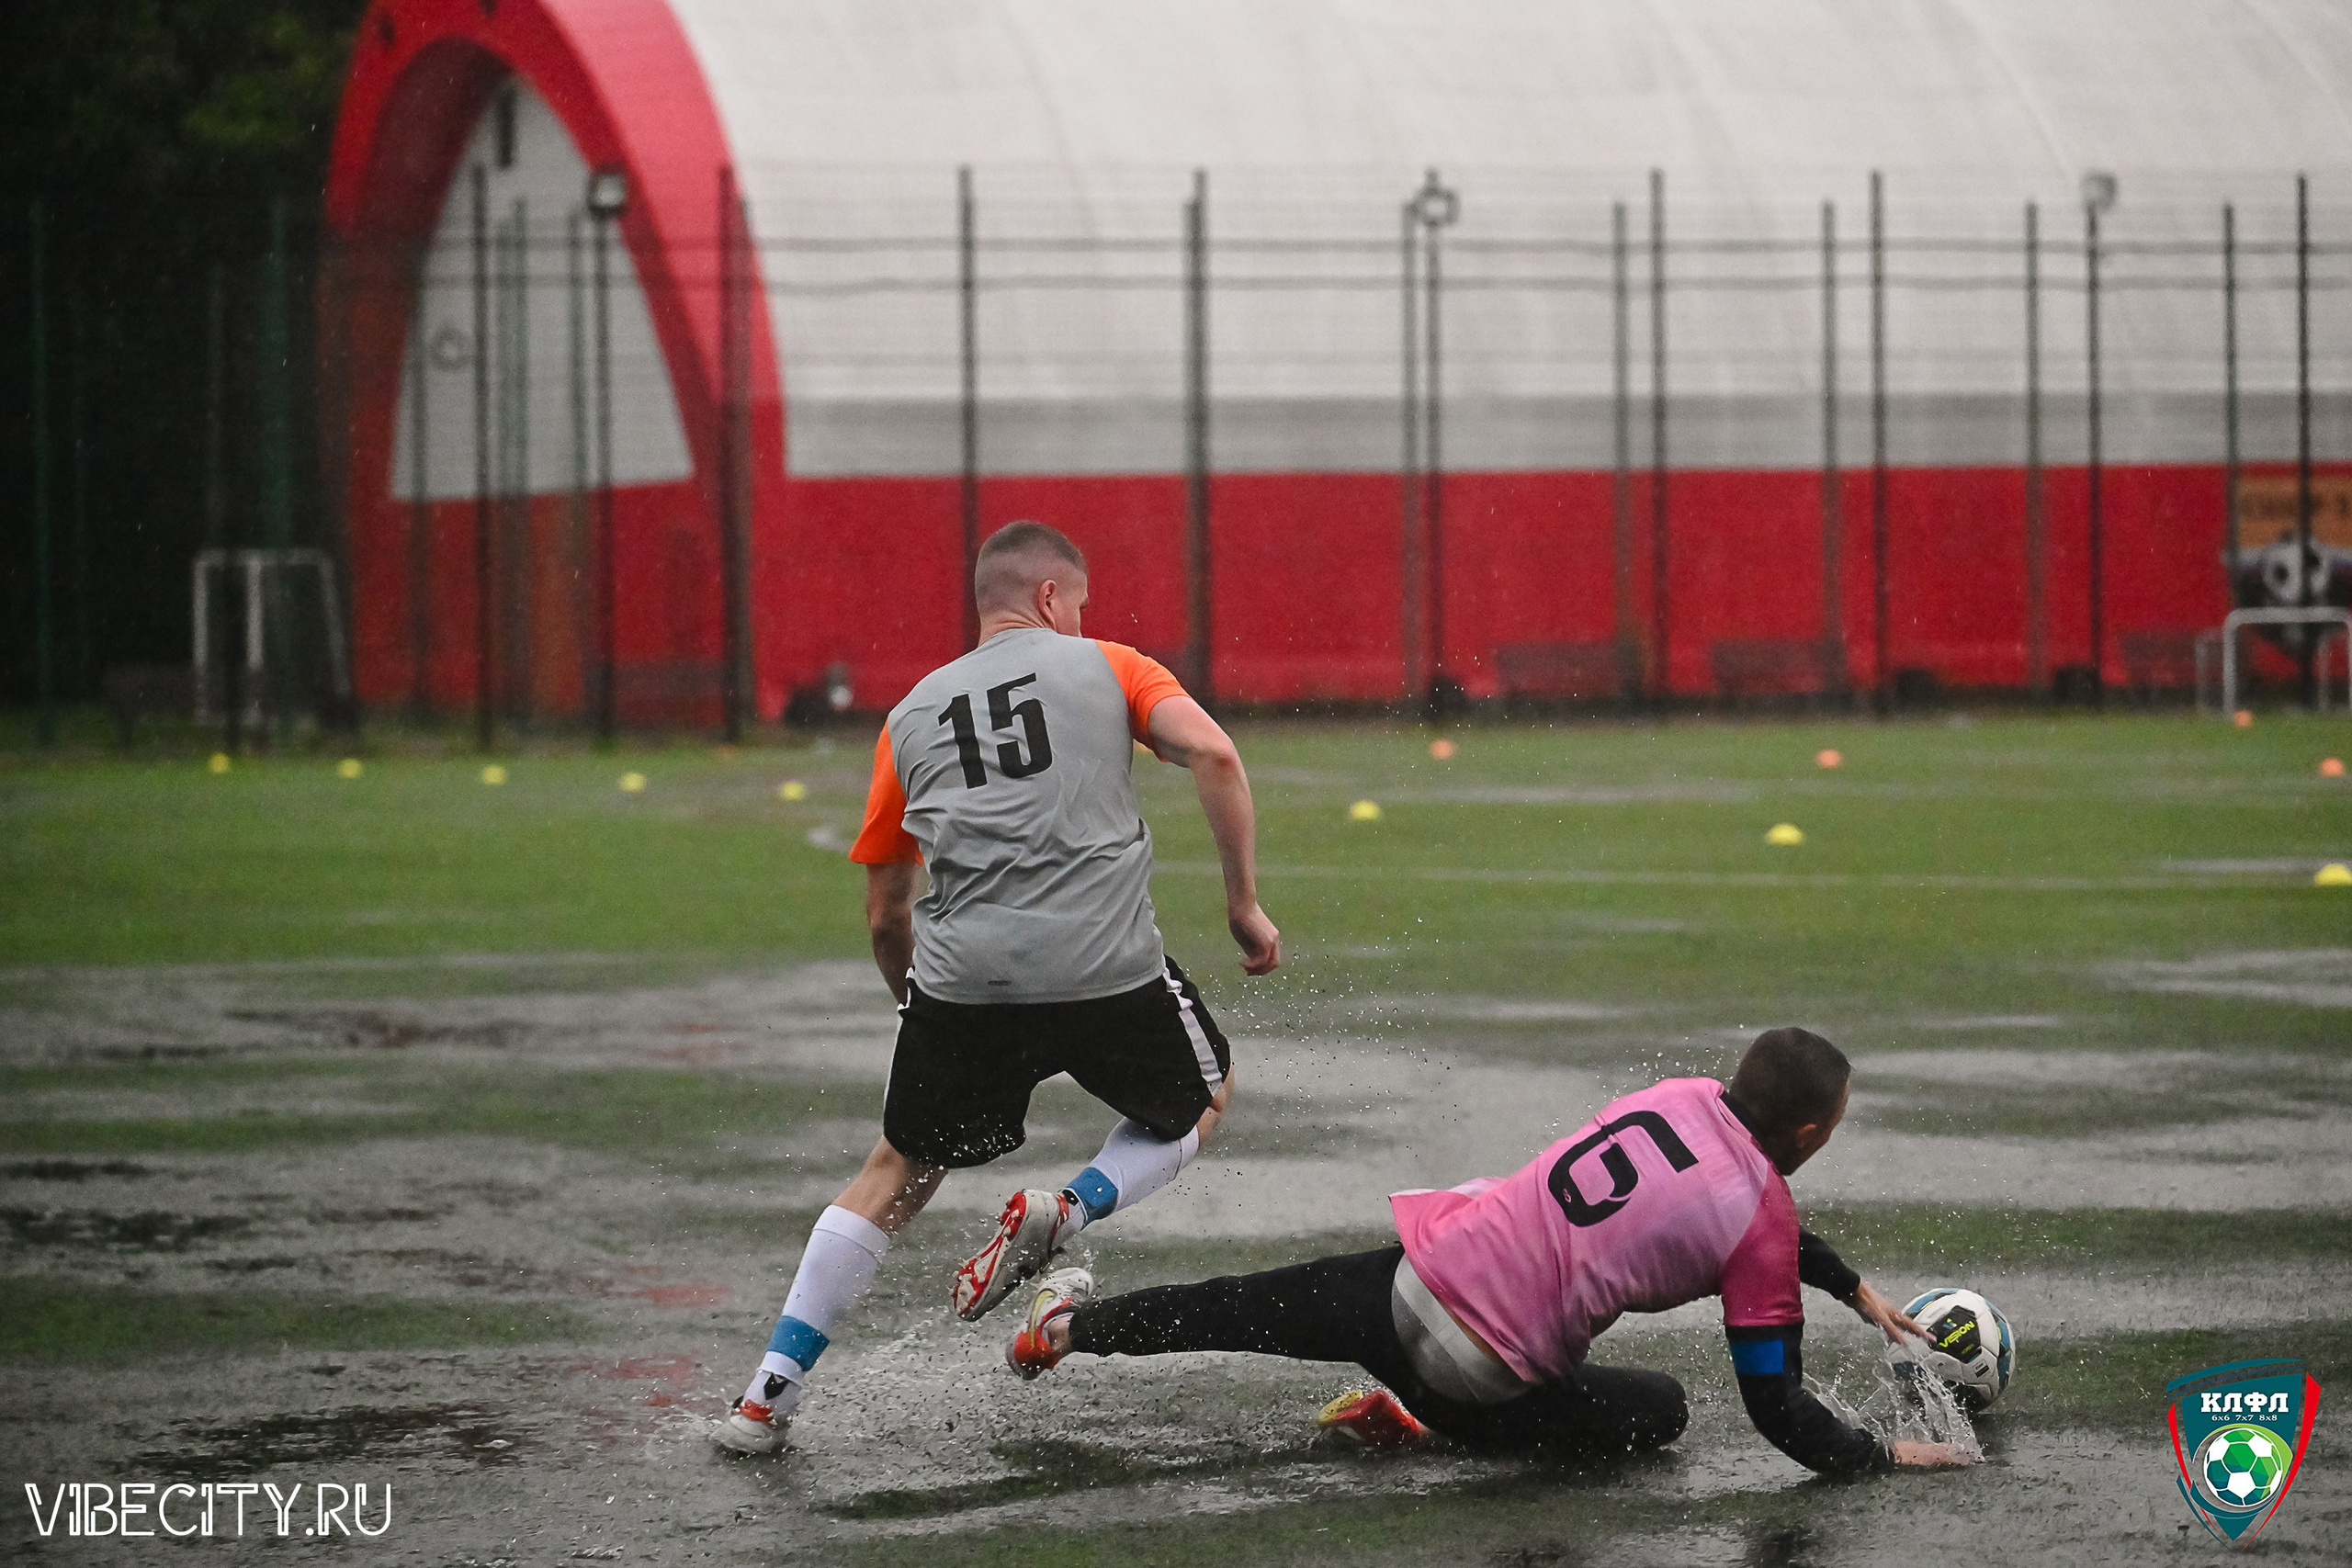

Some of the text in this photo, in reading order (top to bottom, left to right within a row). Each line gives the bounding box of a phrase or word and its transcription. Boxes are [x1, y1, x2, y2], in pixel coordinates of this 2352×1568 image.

[938, 672, 1053, 789] 15
[1547, 1111, 1699, 1227] 6
[1939, 1321, 1975, 1348] VISION
